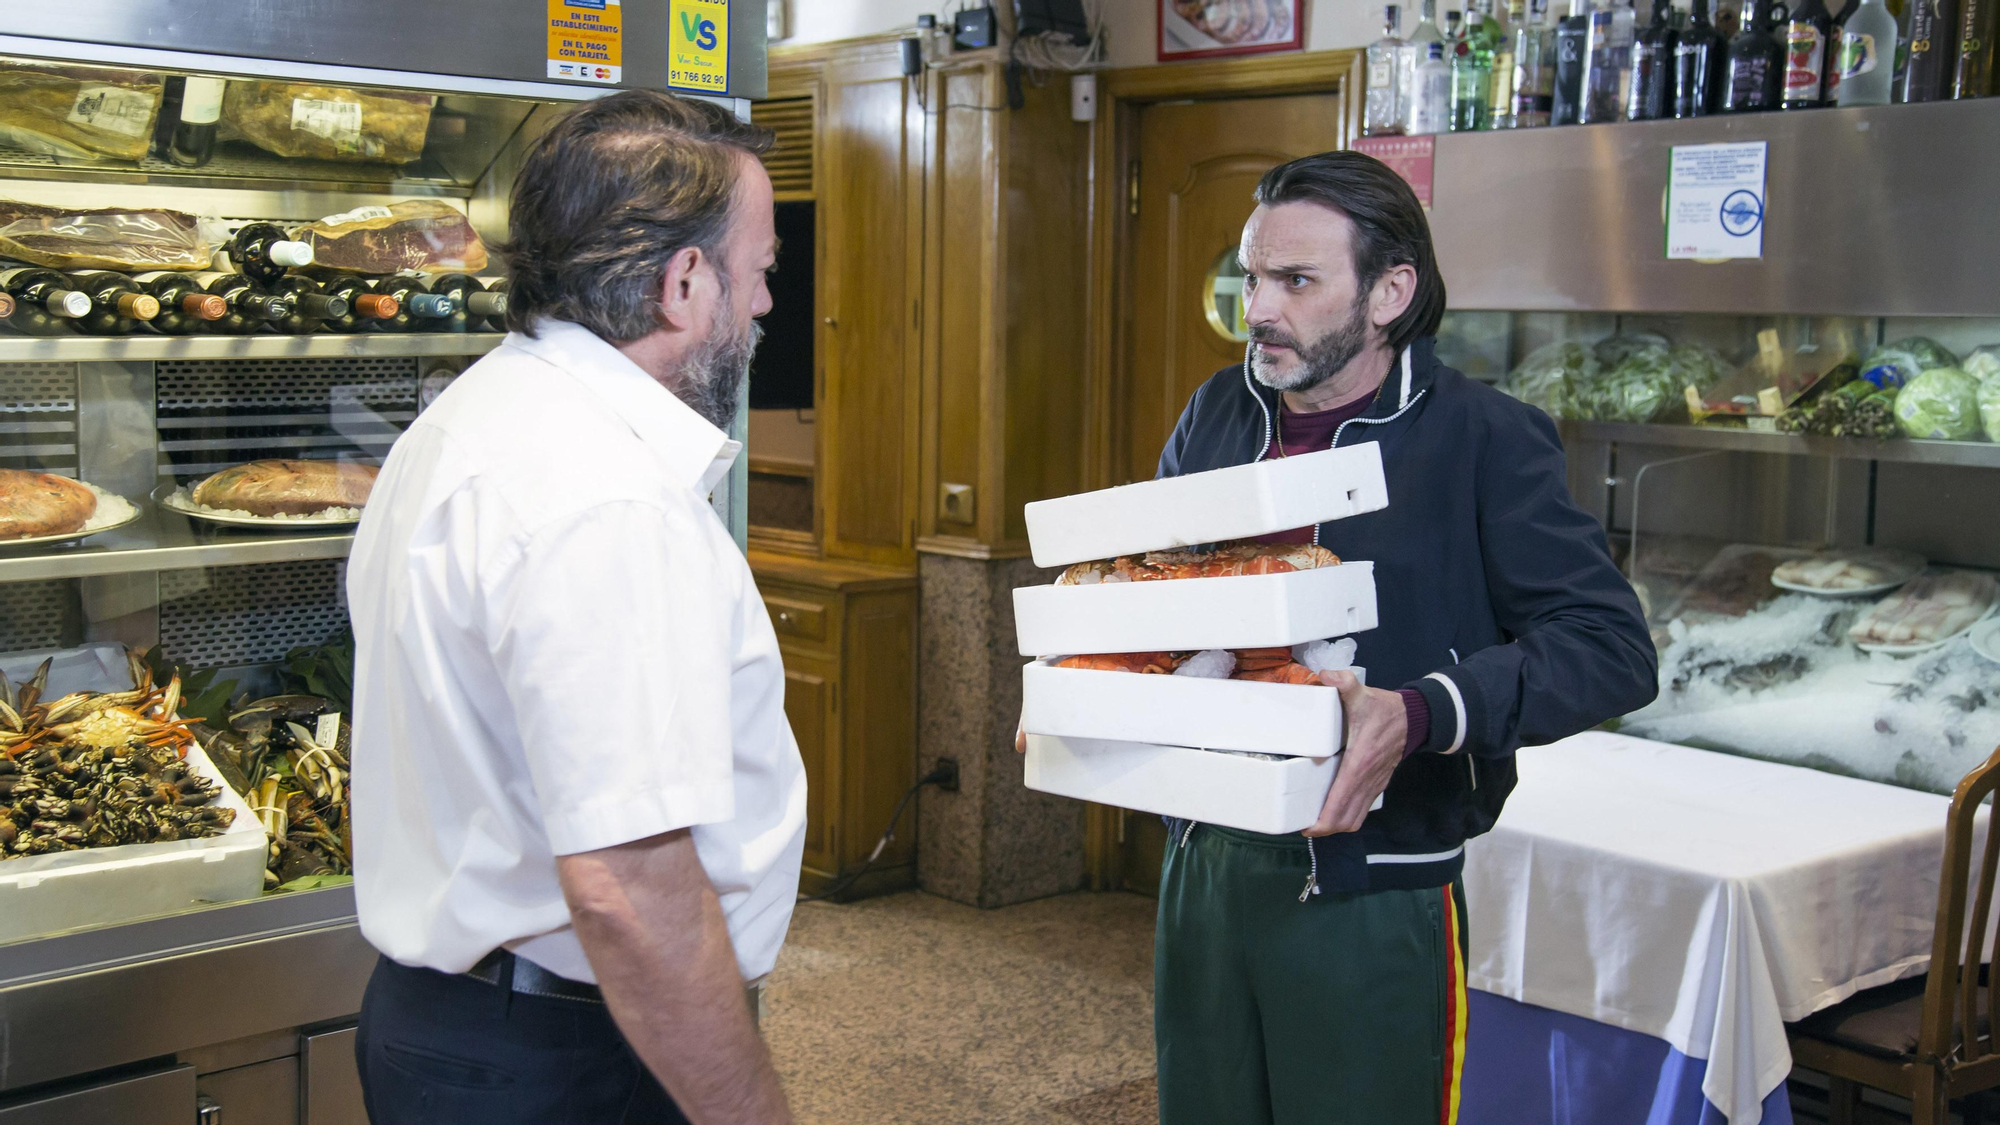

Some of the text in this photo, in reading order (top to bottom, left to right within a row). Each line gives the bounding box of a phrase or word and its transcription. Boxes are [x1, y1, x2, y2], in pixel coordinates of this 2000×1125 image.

[571, 12, 600, 22] EN ESTE
[551, 19, 618, 33] ESTABLECIMIENTO
[575, 41, 583, 49] EL
[586, 42, 607, 51] PAGO
[559, 48, 611, 60] CON TARJETA.
[671, 70, 681, 80] 91
[684, 71, 699, 82] 766
[701, 73, 712, 83] 92
[714, 74, 724, 85] 90
